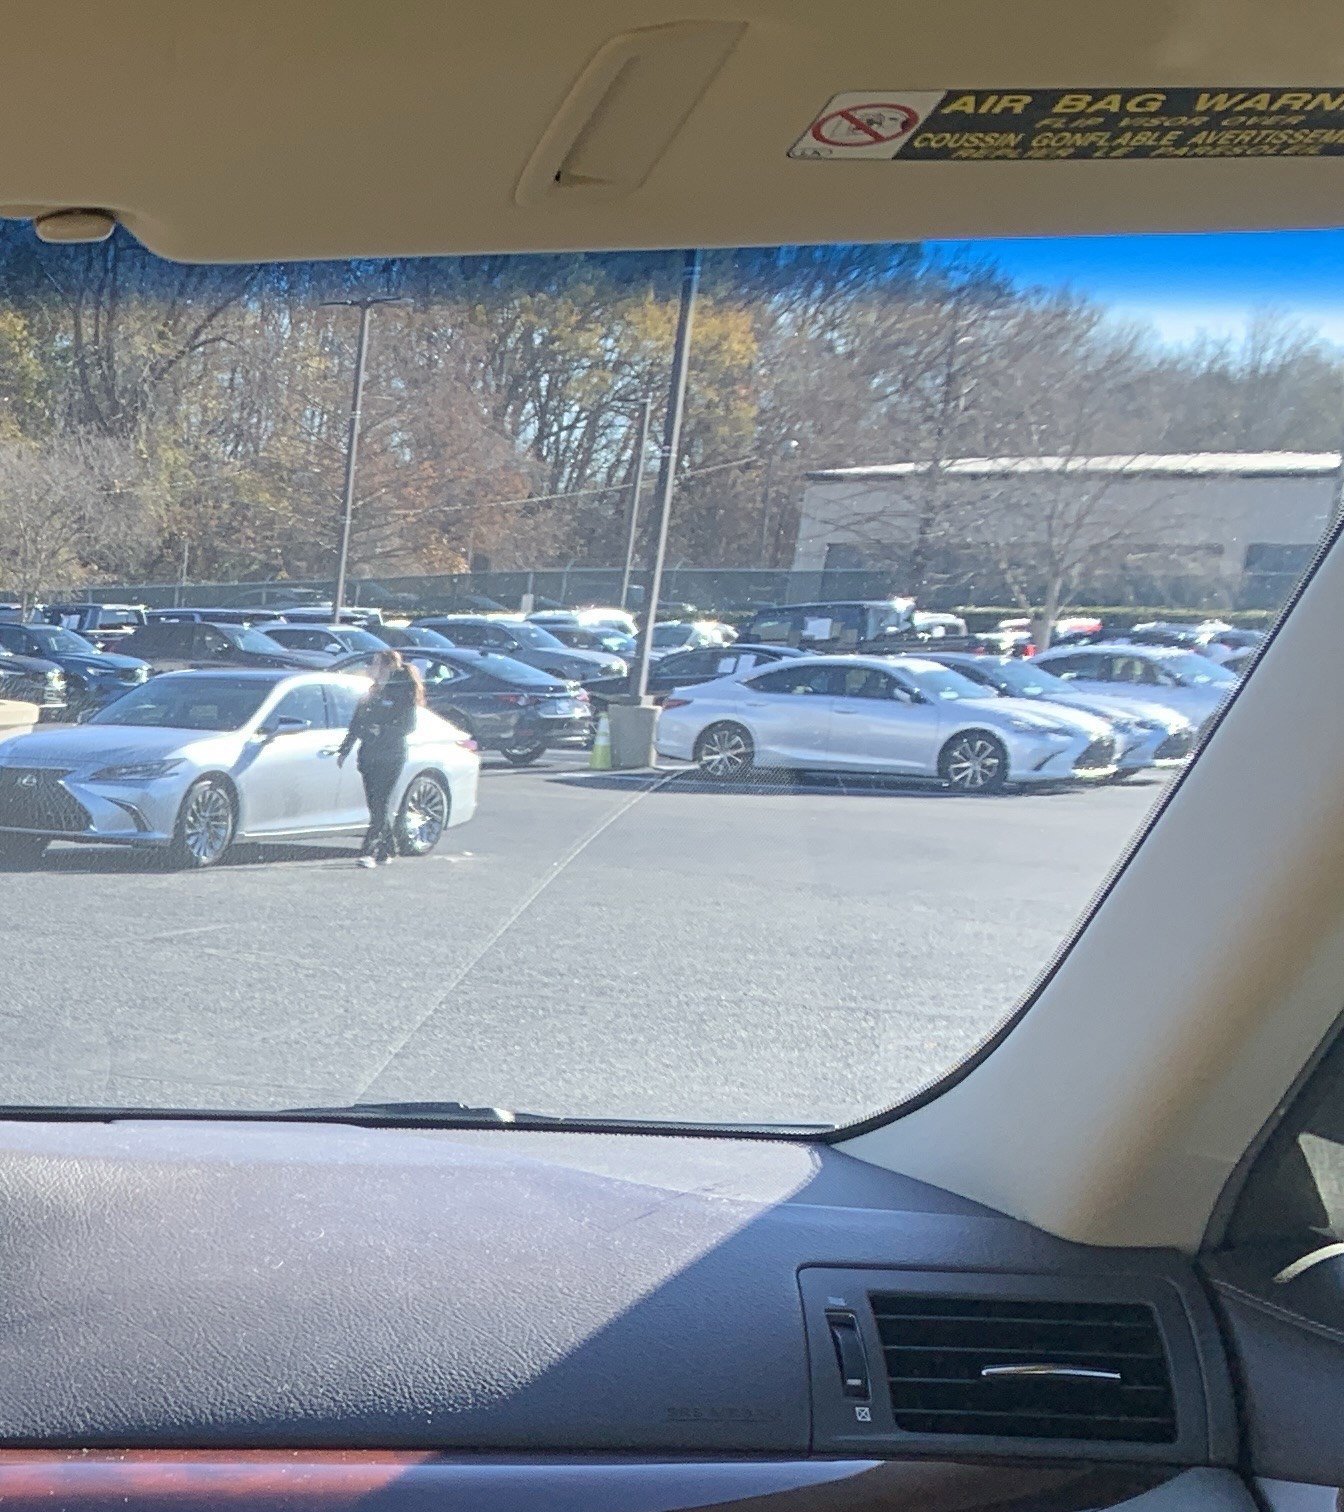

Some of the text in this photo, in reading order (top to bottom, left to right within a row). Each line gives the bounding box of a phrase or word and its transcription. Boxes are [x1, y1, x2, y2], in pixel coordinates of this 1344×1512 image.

[941, 94, 1033, 115] AIR
[1053, 93, 1167, 113] BAG
[913, 132, 1026, 149] COUSSIN
[1030, 130, 1185, 148] GONFLABLE
